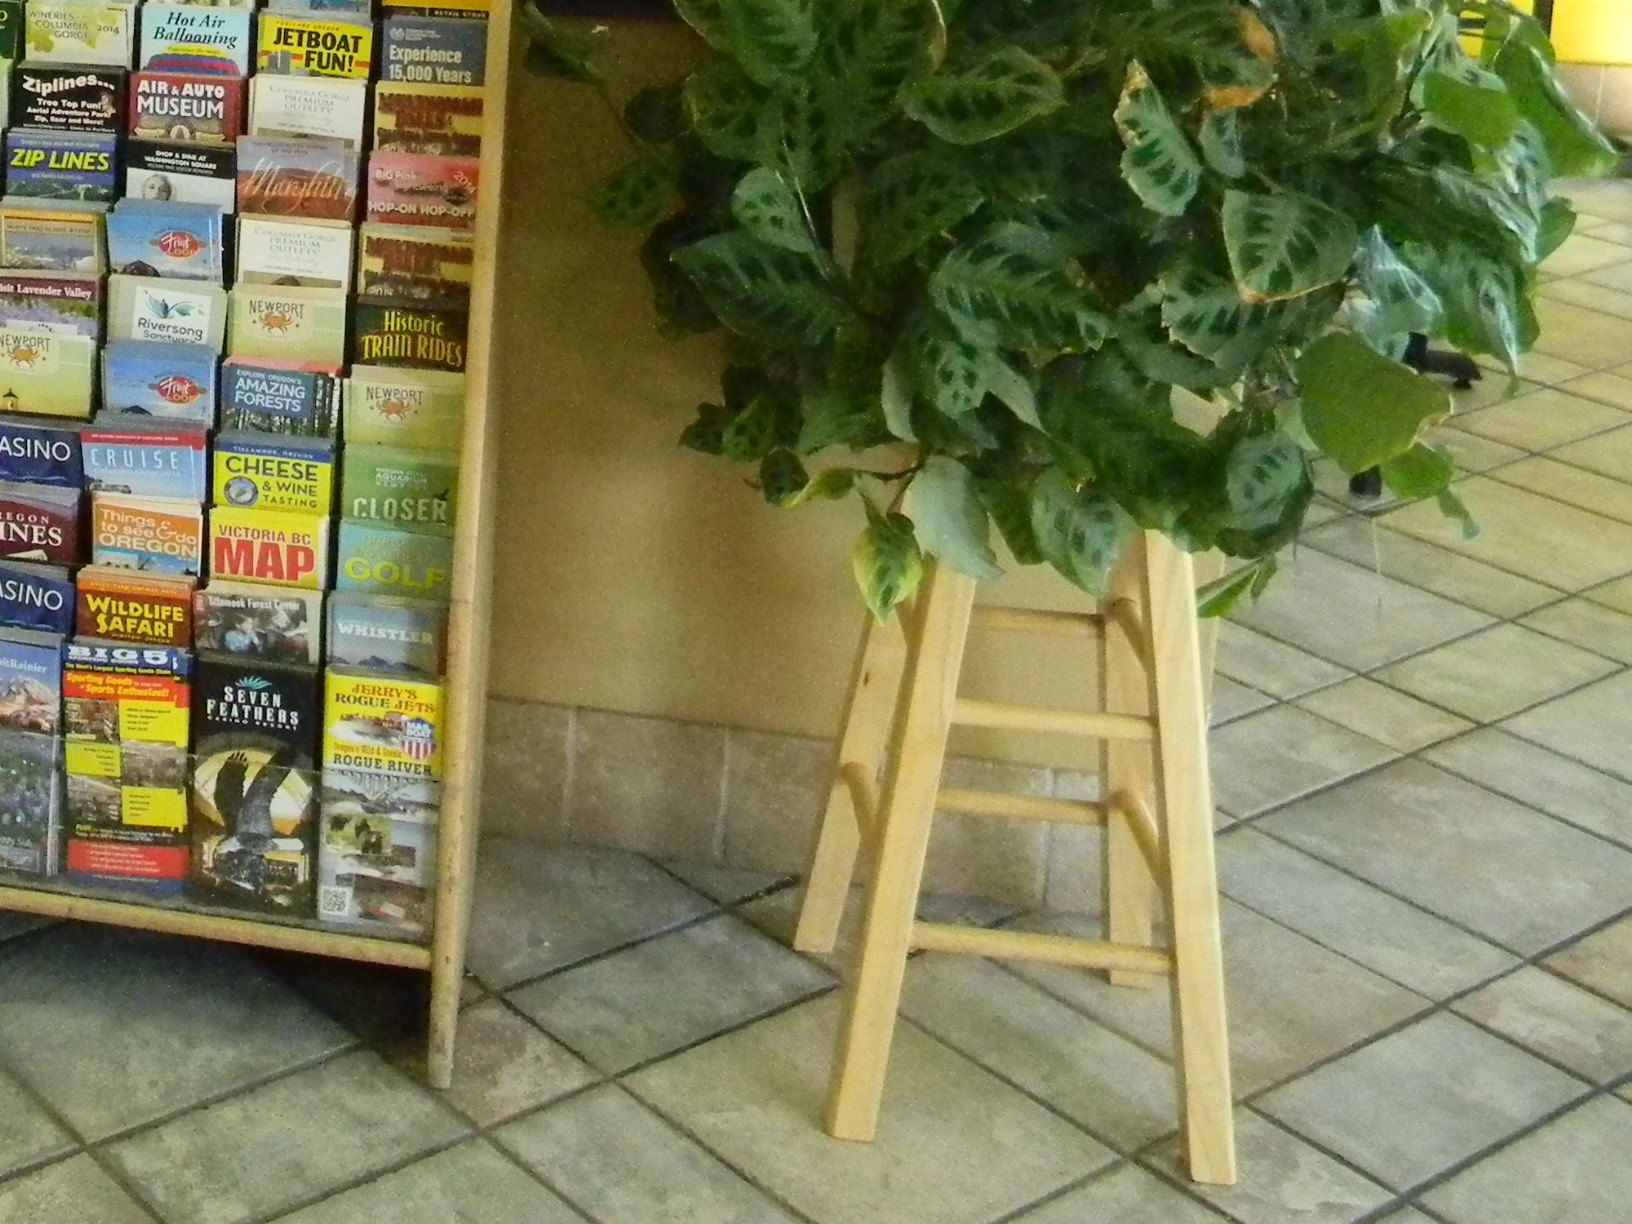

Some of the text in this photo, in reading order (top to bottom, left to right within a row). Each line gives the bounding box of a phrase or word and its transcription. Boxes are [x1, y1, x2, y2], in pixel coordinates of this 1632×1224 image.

[166, 11, 226, 28] Hot Air
[153, 27, 239, 49] Ballooning
[273, 27, 363, 53] JETBOAT
[304, 51, 354, 73] FUN!
[390, 44, 462, 64] Experience
[389, 64, 472, 83] 15,000 Years
[137, 80, 225, 98] AIR & AUTO
[137, 97, 224, 119] MUSEUM
[10, 149, 110, 172] ZIP LINES
[17, 284, 62, 297] Lavender
[64, 286, 93, 300] Valley
[249, 300, 305, 319] NEWPORT
[138, 317, 203, 341] Riversong
[383, 310, 445, 336] Historic
[362, 335, 463, 366] TRAIN RIDES
[235, 377, 306, 399] AMAZING
[366, 386, 423, 405] NEWPORT
[235, 391, 302, 411] FORESTS
[90, 449, 178, 470] CRUISE
[225, 455, 319, 481] CHEESE
[262, 481, 318, 496] & WINE
[262, 494, 318, 508] TASTING
[99, 508, 156, 527] Things
[100, 520, 197, 544] to see do
[219, 524, 311, 545] VICTORIA BC
[98, 534, 198, 557] OREGON
[214, 537, 314, 581] MAP
[344, 557, 445, 588] GOLF
[86, 594, 184, 622] WILDLIFE
[96, 612, 174, 638] SAFARI
[224, 686, 281, 707] SEVEN
[352, 683, 418, 699] JERRY'S
[206, 698, 299, 725] FEATHERS
[333, 754, 432, 776] ROGUE RIVER
